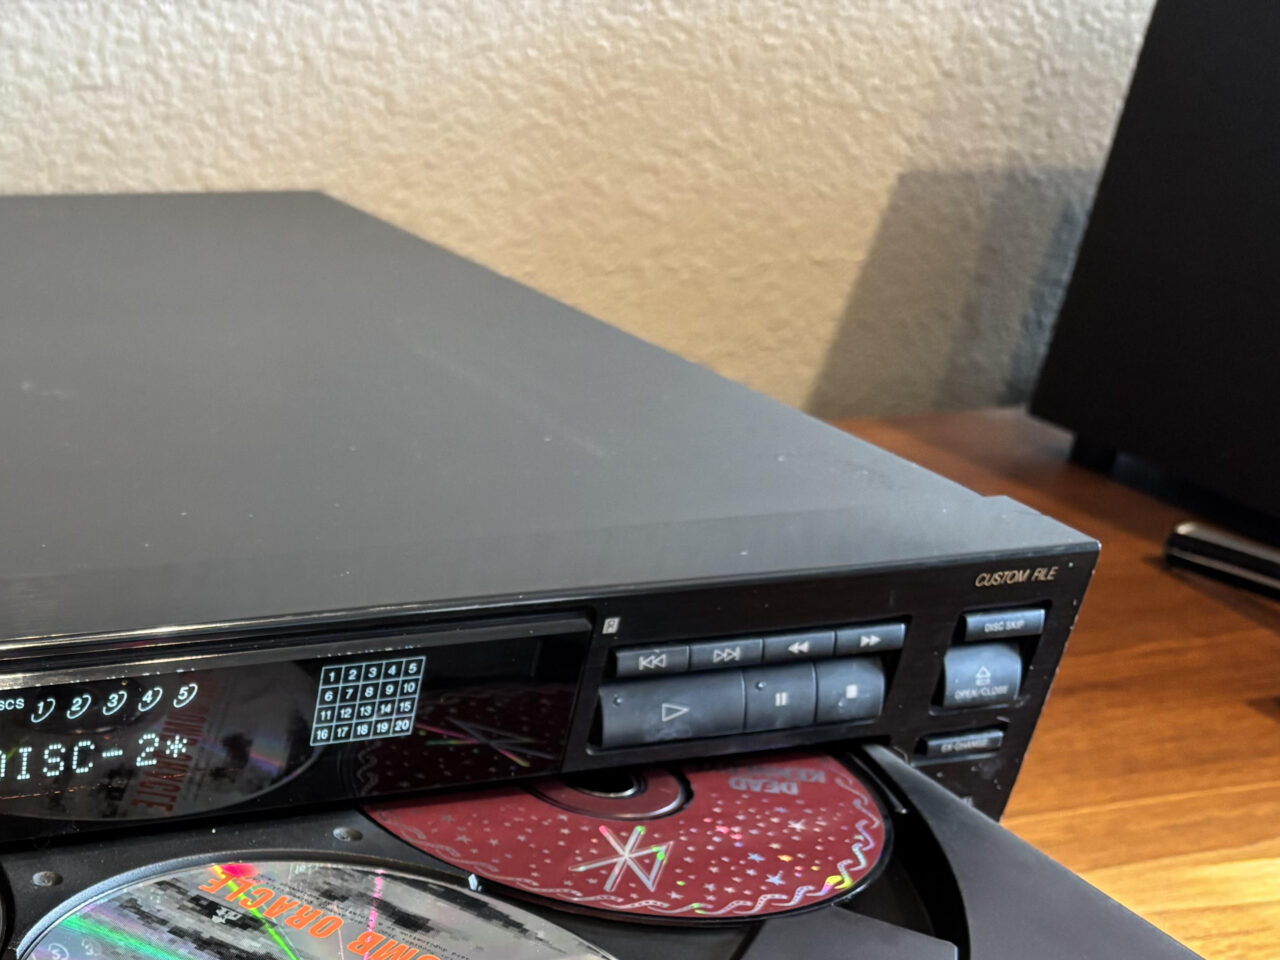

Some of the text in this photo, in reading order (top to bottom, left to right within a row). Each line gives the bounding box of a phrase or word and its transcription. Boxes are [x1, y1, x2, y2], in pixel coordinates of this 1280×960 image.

[975, 567, 1058, 587] CUSTOM FILE
[984, 621, 1024, 632] DISC SKIP
[329, 663, 417, 682] 1 2 3 4 5
[325, 682, 415, 701] 6 7 8 9 10
[955, 685, 1009, 699] OPEN/CLOSE
[321, 702, 411, 720] 11 12 13 14 15
[317, 720, 409, 740] 16 17 18 19 20
[730, 774, 799, 796] DEAD
[198, 870, 345, 939] ORACLE
